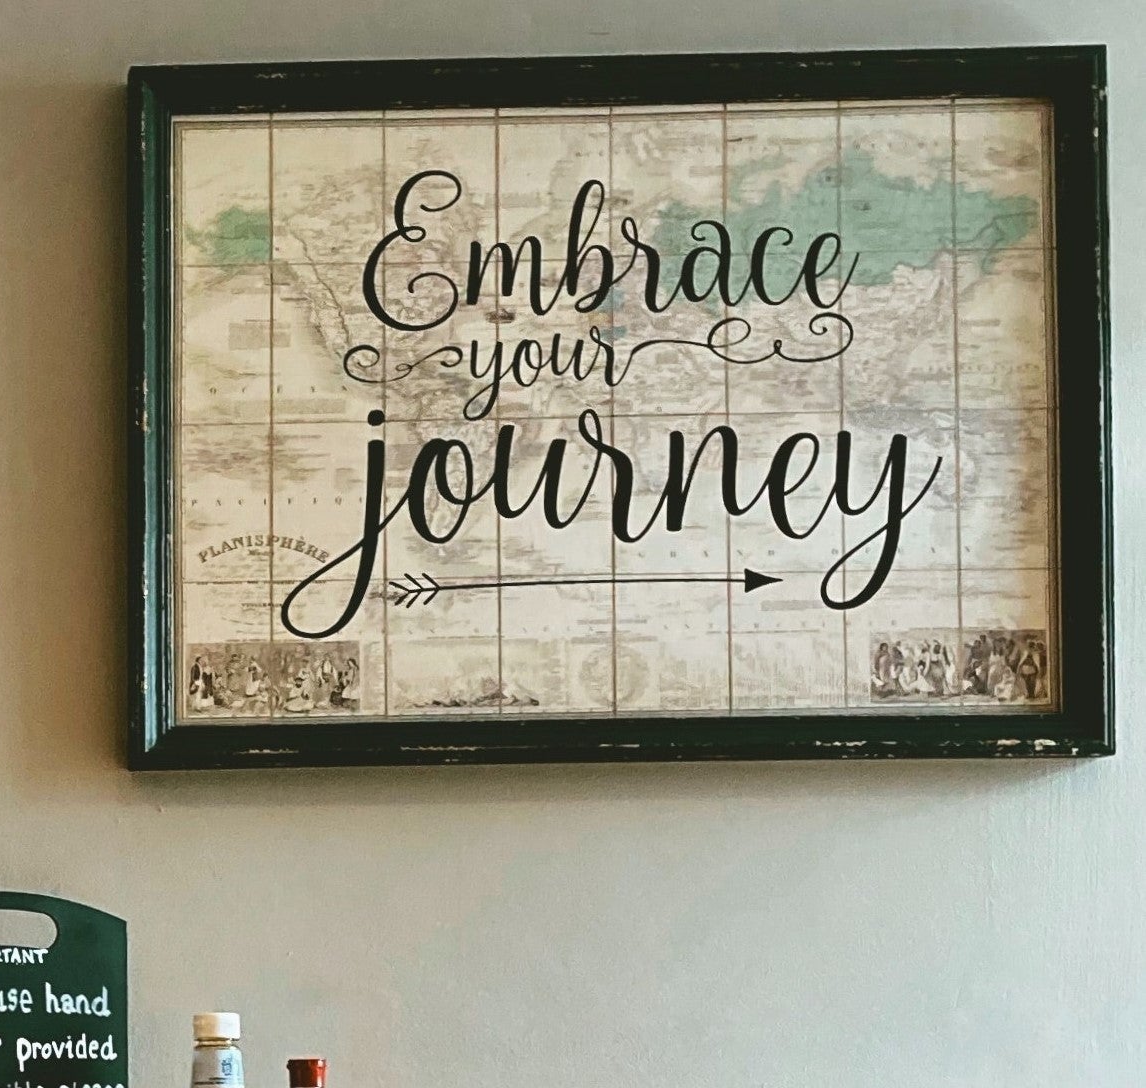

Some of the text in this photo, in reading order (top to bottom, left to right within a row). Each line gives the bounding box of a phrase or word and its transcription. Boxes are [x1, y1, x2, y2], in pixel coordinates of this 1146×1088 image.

[362, 169, 860, 332] Embrace
[462, 325, 636, 421] your
[281, 408, 944, 639] journey
[45, 981, 111, 1017] hand
[16, 1033, 118, 1074] provided
